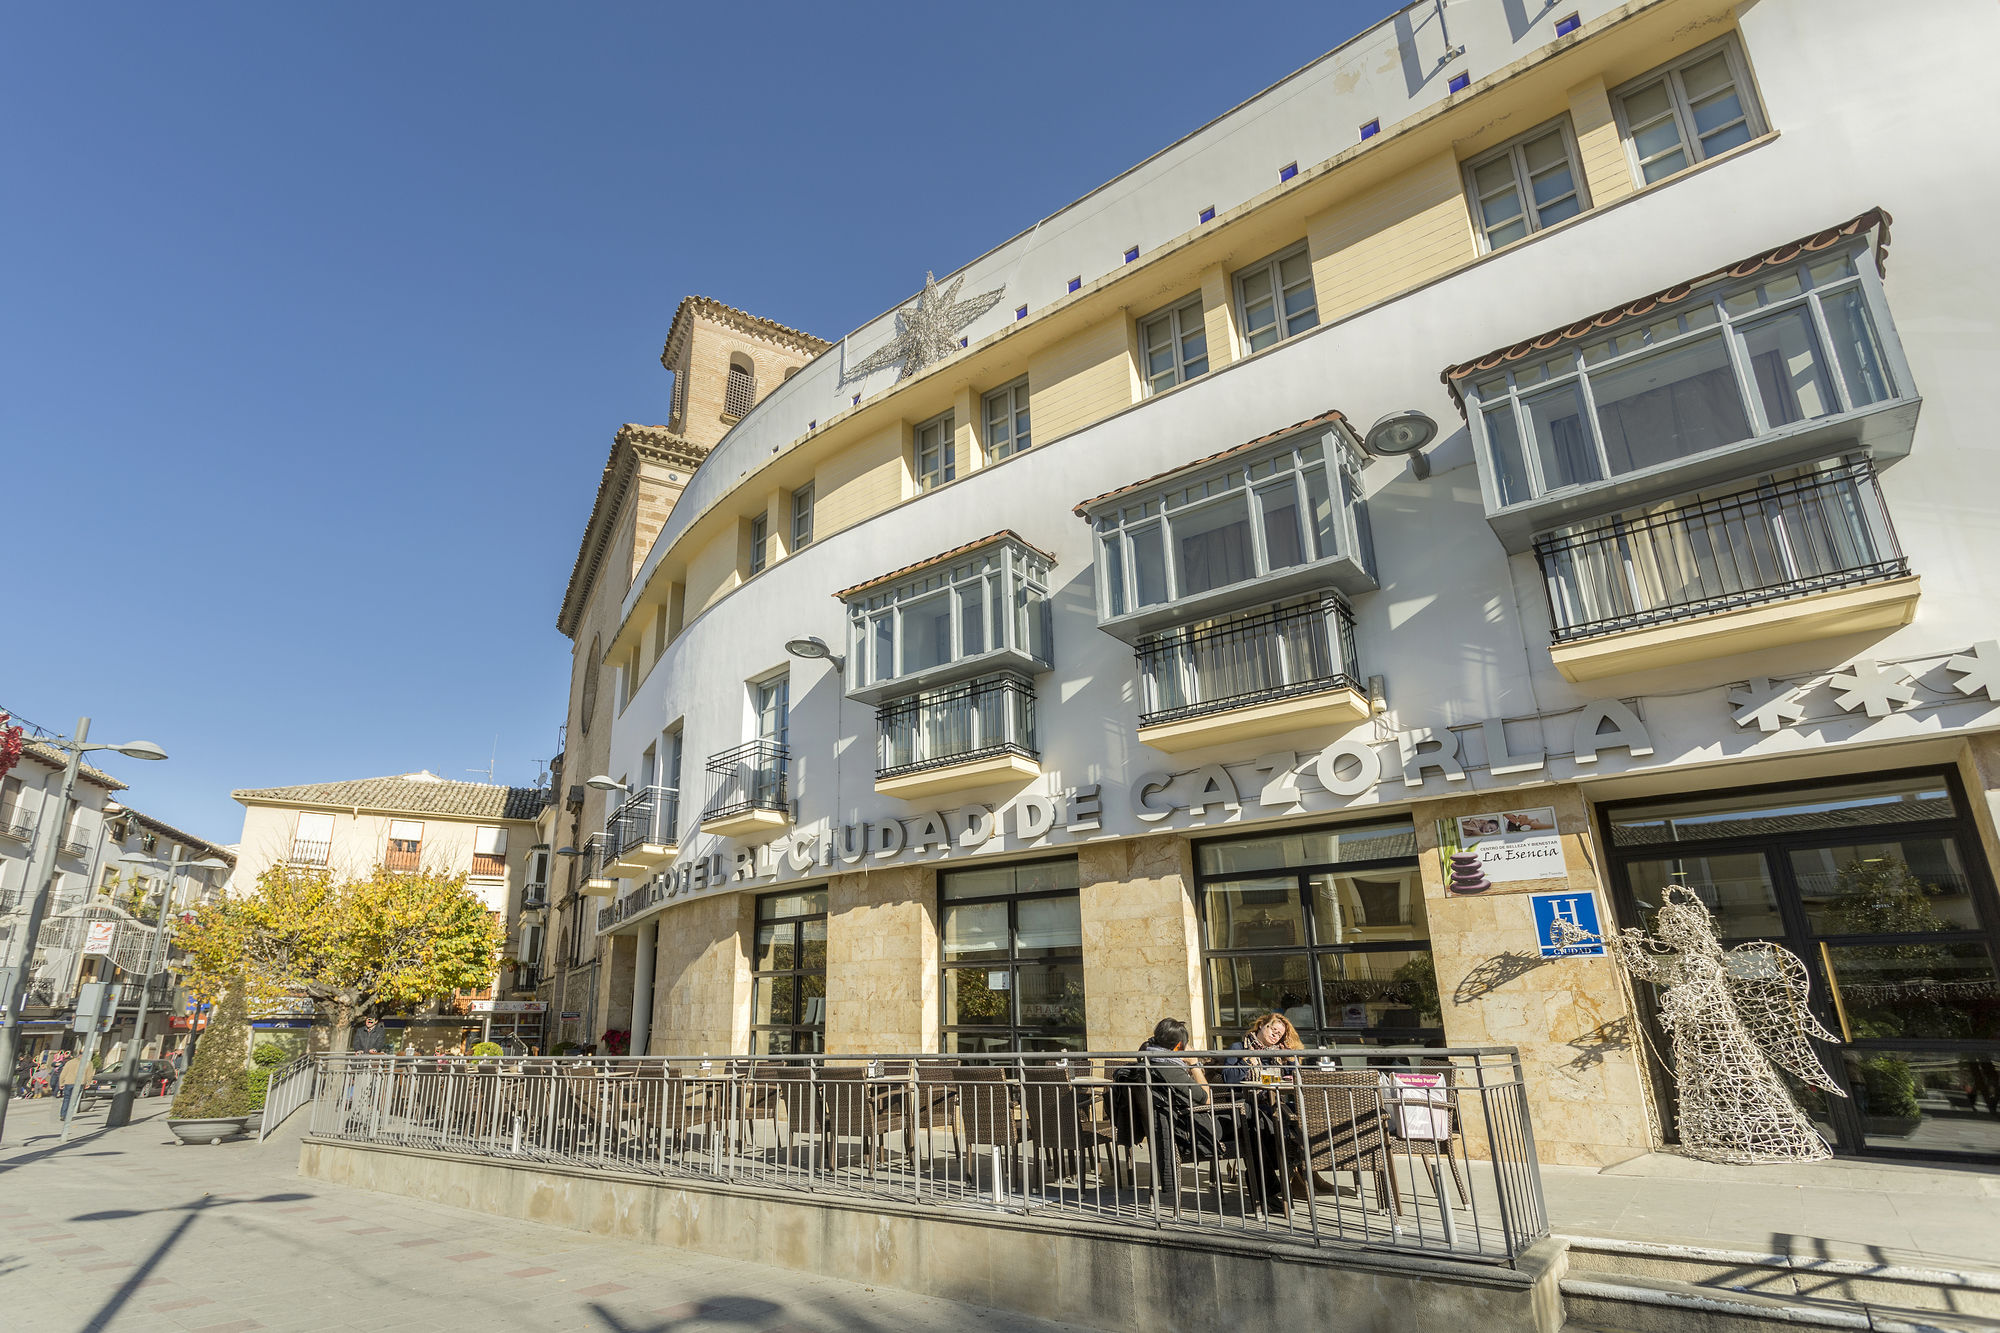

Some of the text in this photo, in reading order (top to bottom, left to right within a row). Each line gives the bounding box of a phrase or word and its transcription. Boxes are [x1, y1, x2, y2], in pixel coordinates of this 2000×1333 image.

[650, 853, 727, 906] HOTEL
[787, 803, 996, 872] CIUDAD
[1015, 783, 1102, 840] DE
[1129, 698, 1655, 823] CAZORLA
[1482, 845, 1559, 862] La Esencia
[1547, 898, 1584, 928] H
[1553, 947, 1592, 955] CIUDAD
